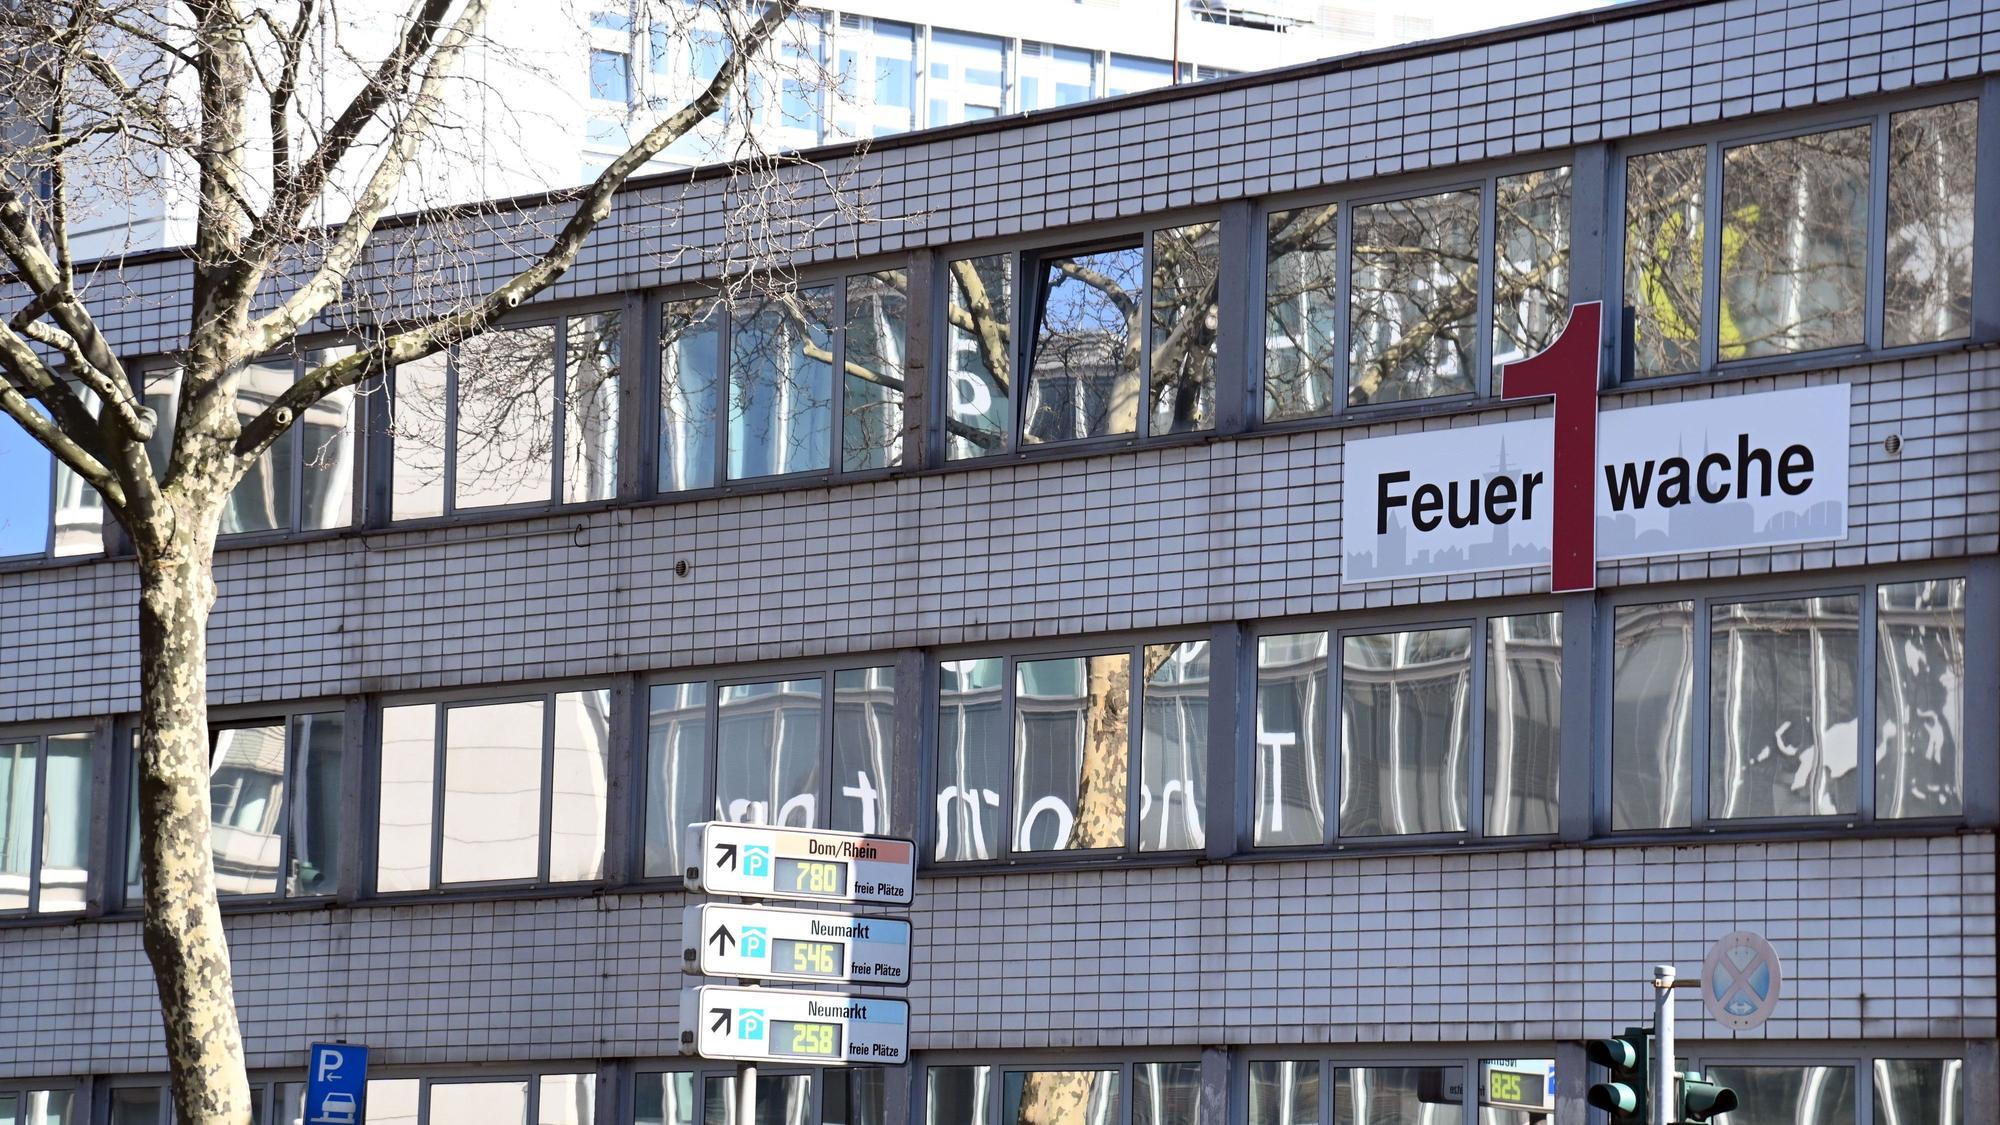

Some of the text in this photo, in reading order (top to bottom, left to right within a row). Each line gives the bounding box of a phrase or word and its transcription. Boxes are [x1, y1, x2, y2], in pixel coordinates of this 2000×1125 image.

[1376, 300, 1815, 594] Feuer 1 wache
[808, 839, 877, 859] Dom/Rhein
[749, 855, 762, 875] P
[796, 862, 837, 892] 780
[854, 881, 904, 897] freie Plätze
[810, 920, 870, 939] Neumarkt
[747, 937, 760, 957] P
[794, 943, 834, 973] 546
[851, 961, 901, 977] freie Plätze
[808, 1000, 867, 1020] Neumarkt
[744, 1018, 757, 1038] P
[792, 1023, 833, 1054] 258
[849, 1042, 899, 1057] freie Plätze
[318, 1049, 344, 1082] P
